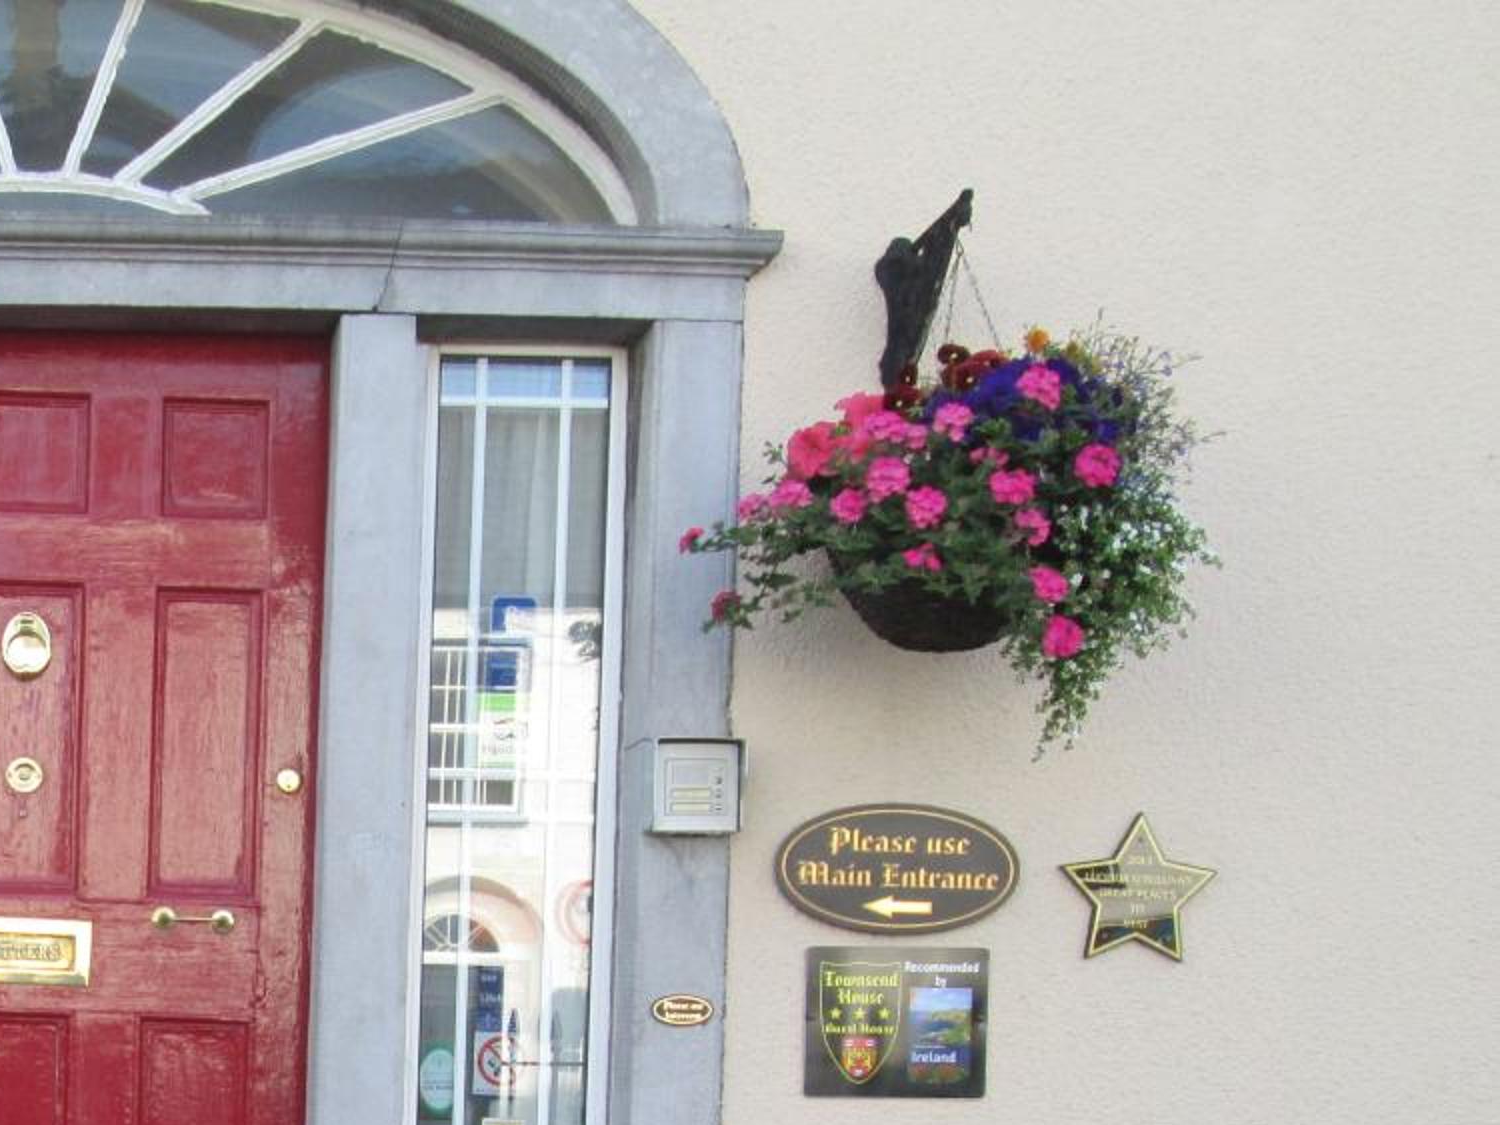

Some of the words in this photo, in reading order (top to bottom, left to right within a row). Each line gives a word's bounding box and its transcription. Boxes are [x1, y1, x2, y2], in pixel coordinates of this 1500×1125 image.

[829, 826, 917, 855] Please
[927, 836, 972, 855] use
[798, 860, 872, 886] Main
[882, 862, 999, 890] Entrance
[904, 961, 980, 974] Recommended
[825, 971, 898, 988] Townsend
[934, 975, 948, 988] by
[837, 989, 885, 1005] House
[861, 1023, 895, 1034] House
[911, 1051, 957, 1063] Ireland
